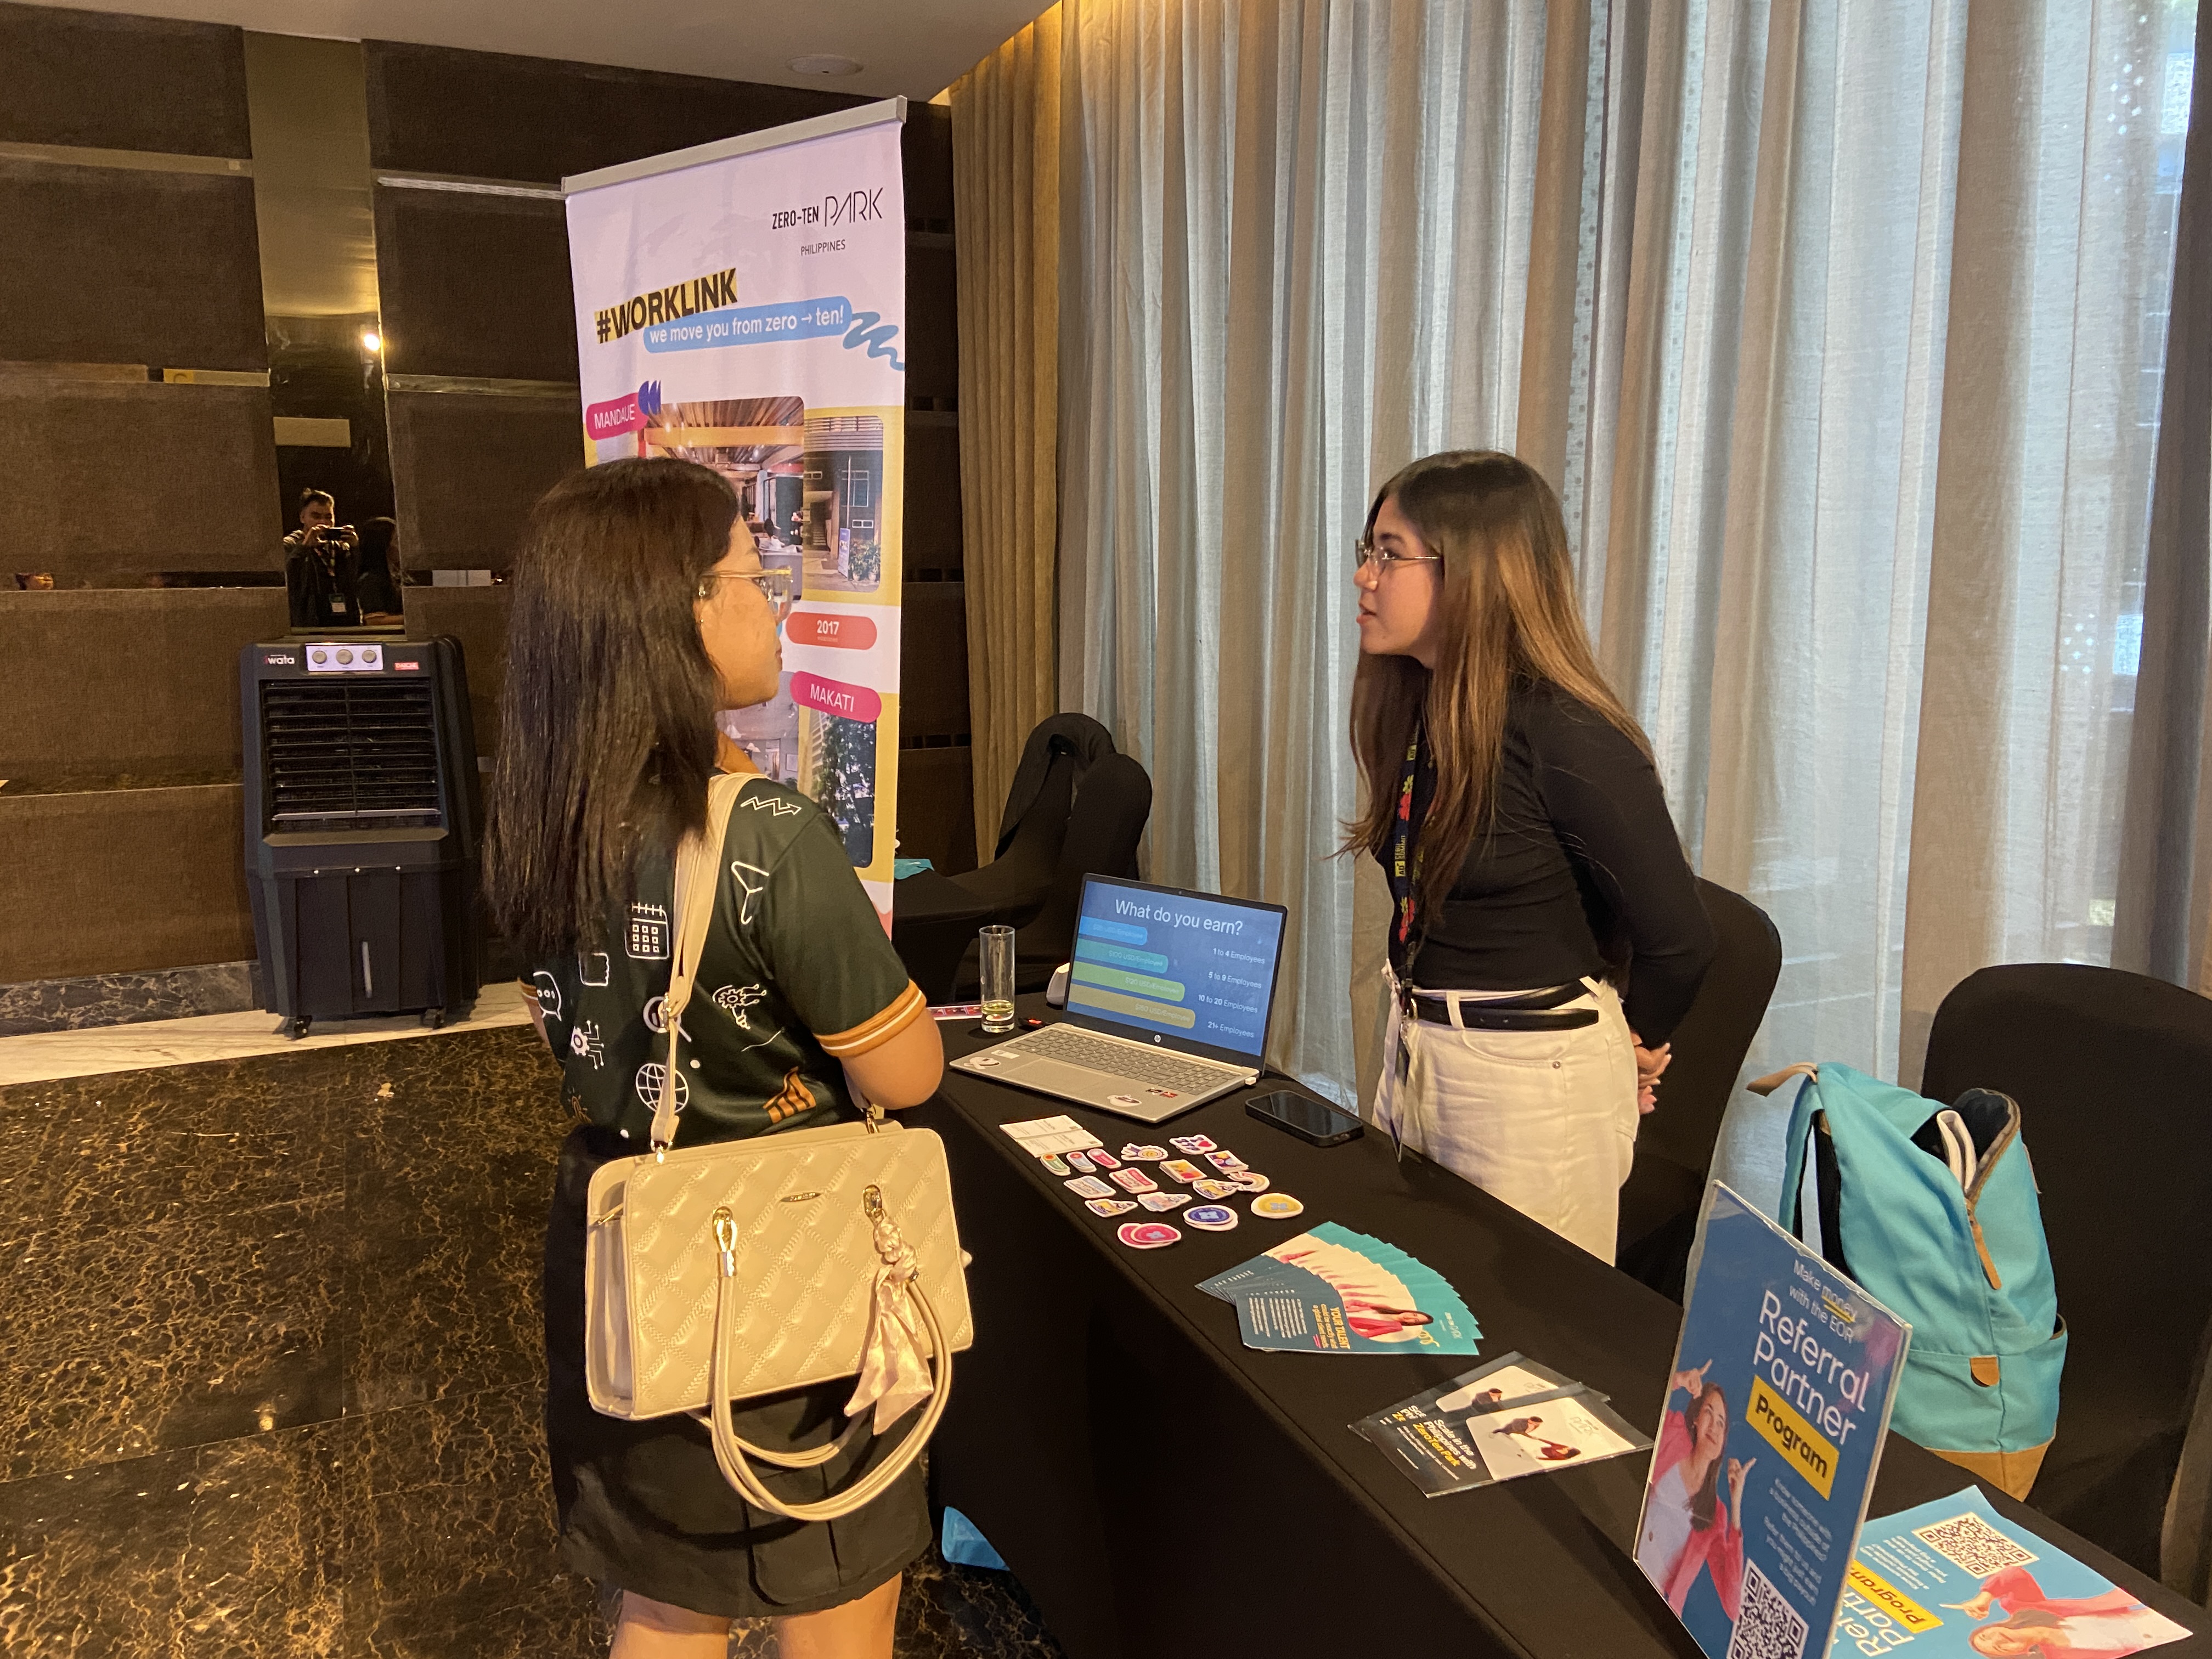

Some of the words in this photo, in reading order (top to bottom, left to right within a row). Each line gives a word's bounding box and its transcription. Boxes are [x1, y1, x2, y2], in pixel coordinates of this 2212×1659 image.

[771, 205, 819, 230] ZERO-TEN
[825, 187, 883, 227] PARK
[800, 239, 846, 256] PHILIPPINES
[596, 267, 738, 344] #WORKLINK
[650, 330, 667, 343] we
[670, 325, 703, 341] move
[707, 323, 729, 341] you
[733, 318, 761, 335] from
[765, 315, 797, 332] zero
[816, 304, 844, 325] ten!
[594, 403, 635, 430] MANDAUE
[817, 619, 839, 635] 2017
[810, 684, 855, 713] MAKATI
[1115, 899, 1150, 919] What
[1154, 907, 1171, 923] do
[1173, 913, 1199, 928] you
[1203, 918, 1243, 935] earn?
[1231, 951, 1265, 964] Employees
[1214, 972, 1221, 980] to
[1227, 976, 1262, 989] Employees
[1214, 997, 1222, 1006] 20
[1223, 1000, 1258, 1013] Employees
[1207, 1021, 1218, 1029] 21+
[1220, 1024, 1254, 1038] Employees
[1793, 1259, 1821, 1291] Make
[1821, 1285, 1858, 1317] money
[1790, 1285, 1810, 1310] with
[1811, 1299, 1828, 1323] the
[1829, 1315, 1854, 1344] EOR
[1759, 1289, 1870, 1413] Referral
[1753, 1331, 1857, 1446] Partner
[1424, 1420, 1461, 1457] Philippines
[1459, 1454, 1477, 1470] with
[1434, 1419, 1455, 1441] Scale
[1452, 1437, 1463, 1447] in
[1459, 1444, 1474, 1457] the
[1755, 1392, 1829, 1479] Program
